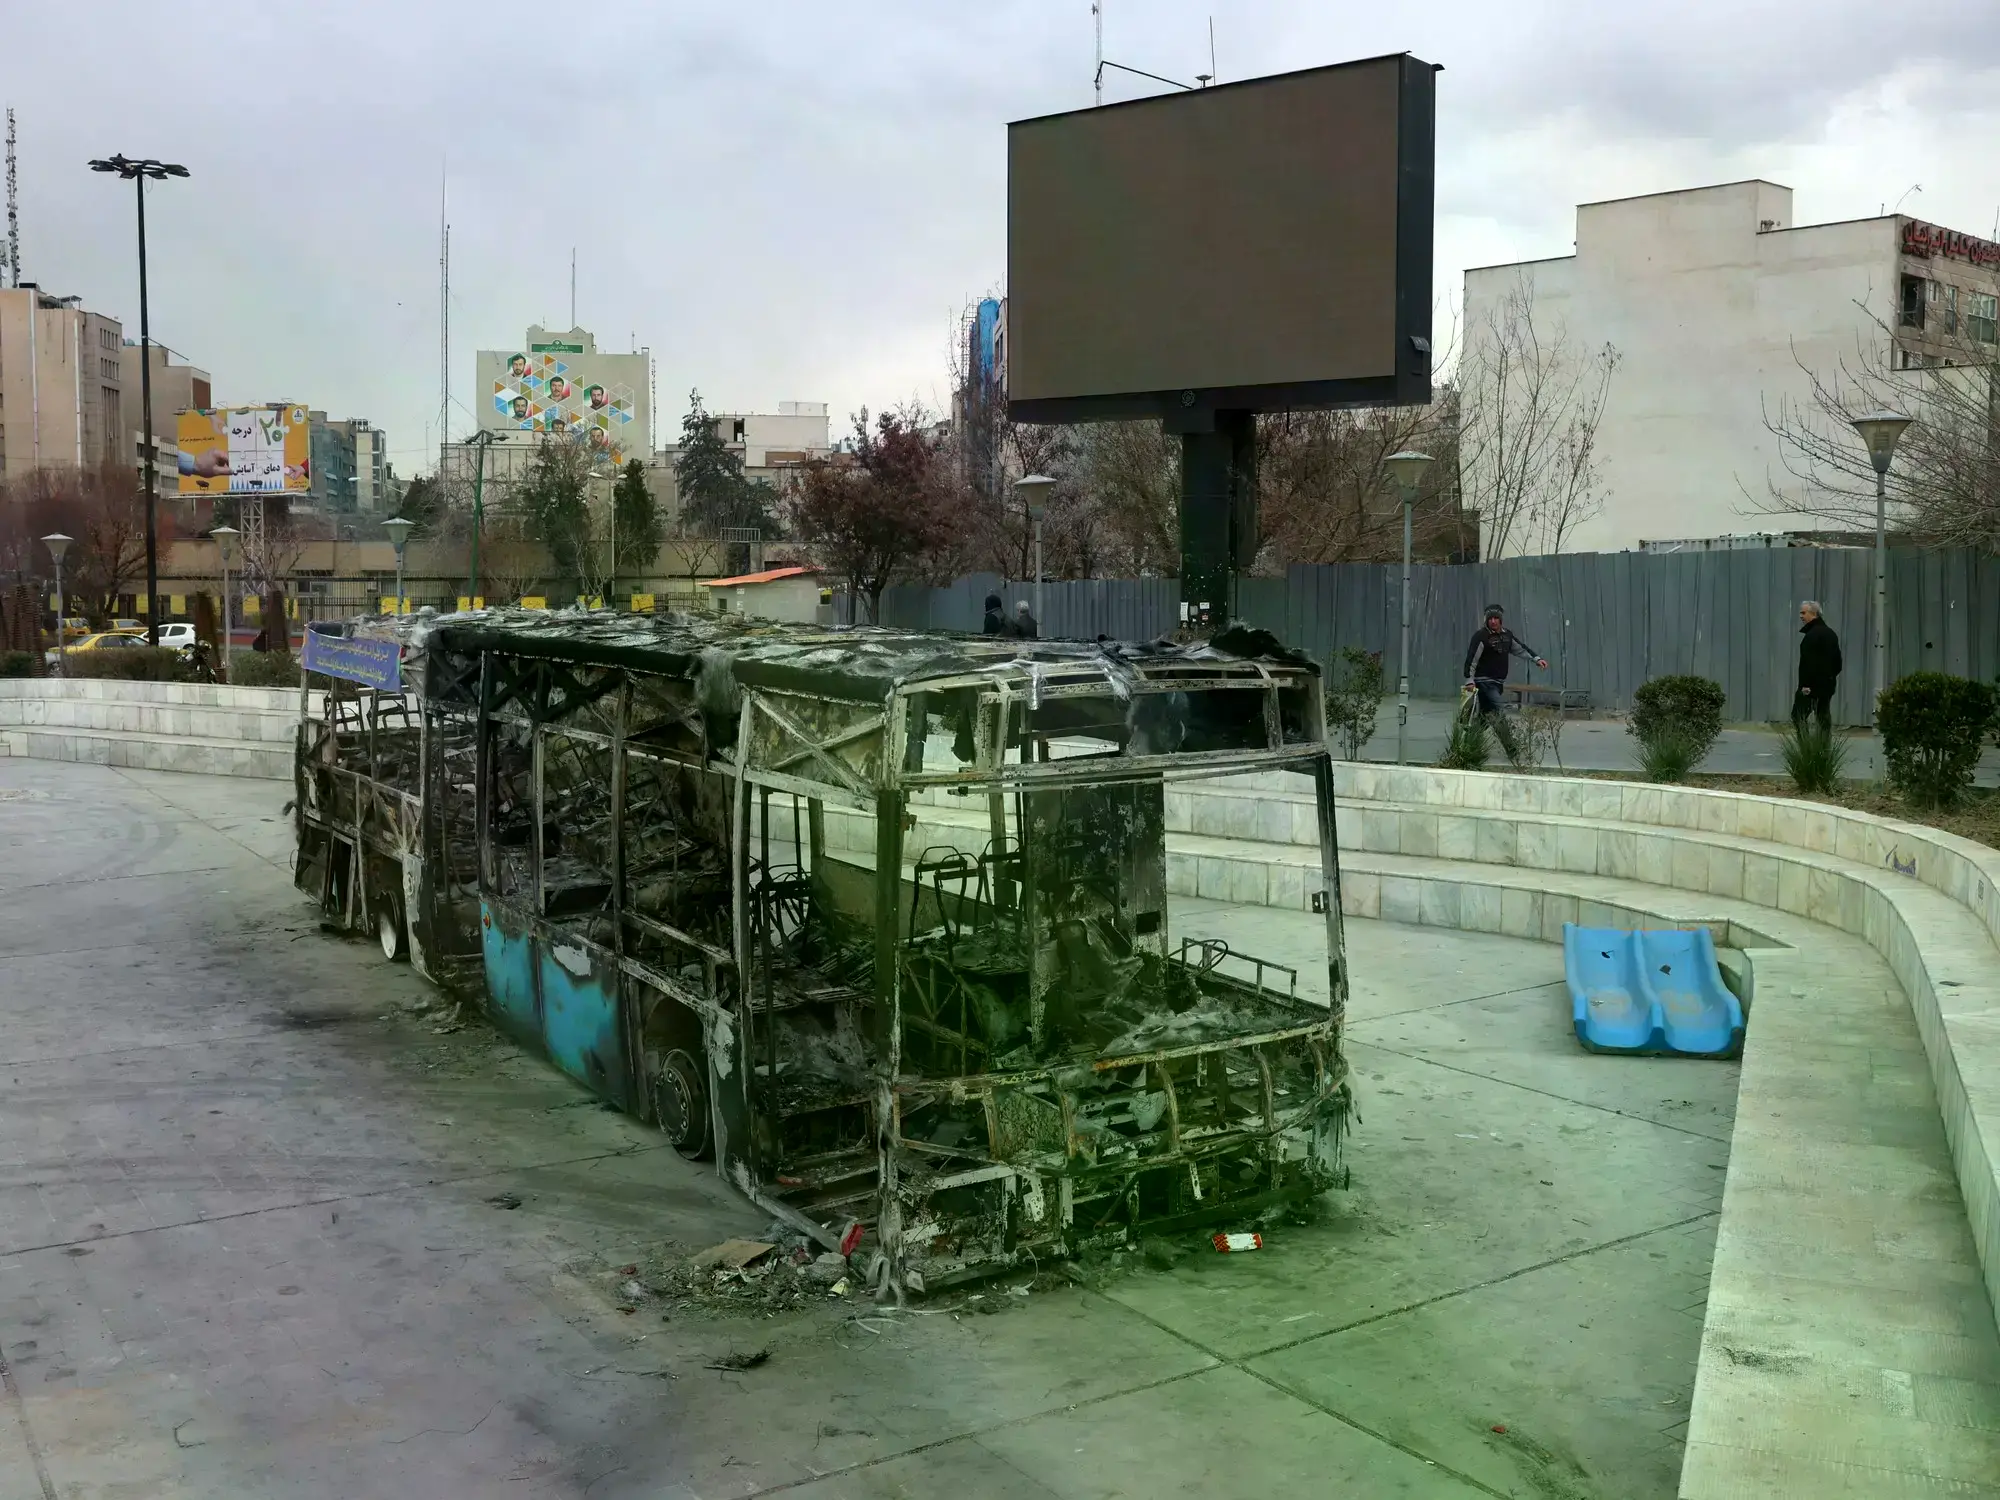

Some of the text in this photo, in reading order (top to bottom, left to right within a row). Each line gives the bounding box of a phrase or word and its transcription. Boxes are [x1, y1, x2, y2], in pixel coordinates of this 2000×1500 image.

[231, 426, 252, 438] درجه
[233, 463, 281, 476] دمای آسایش
